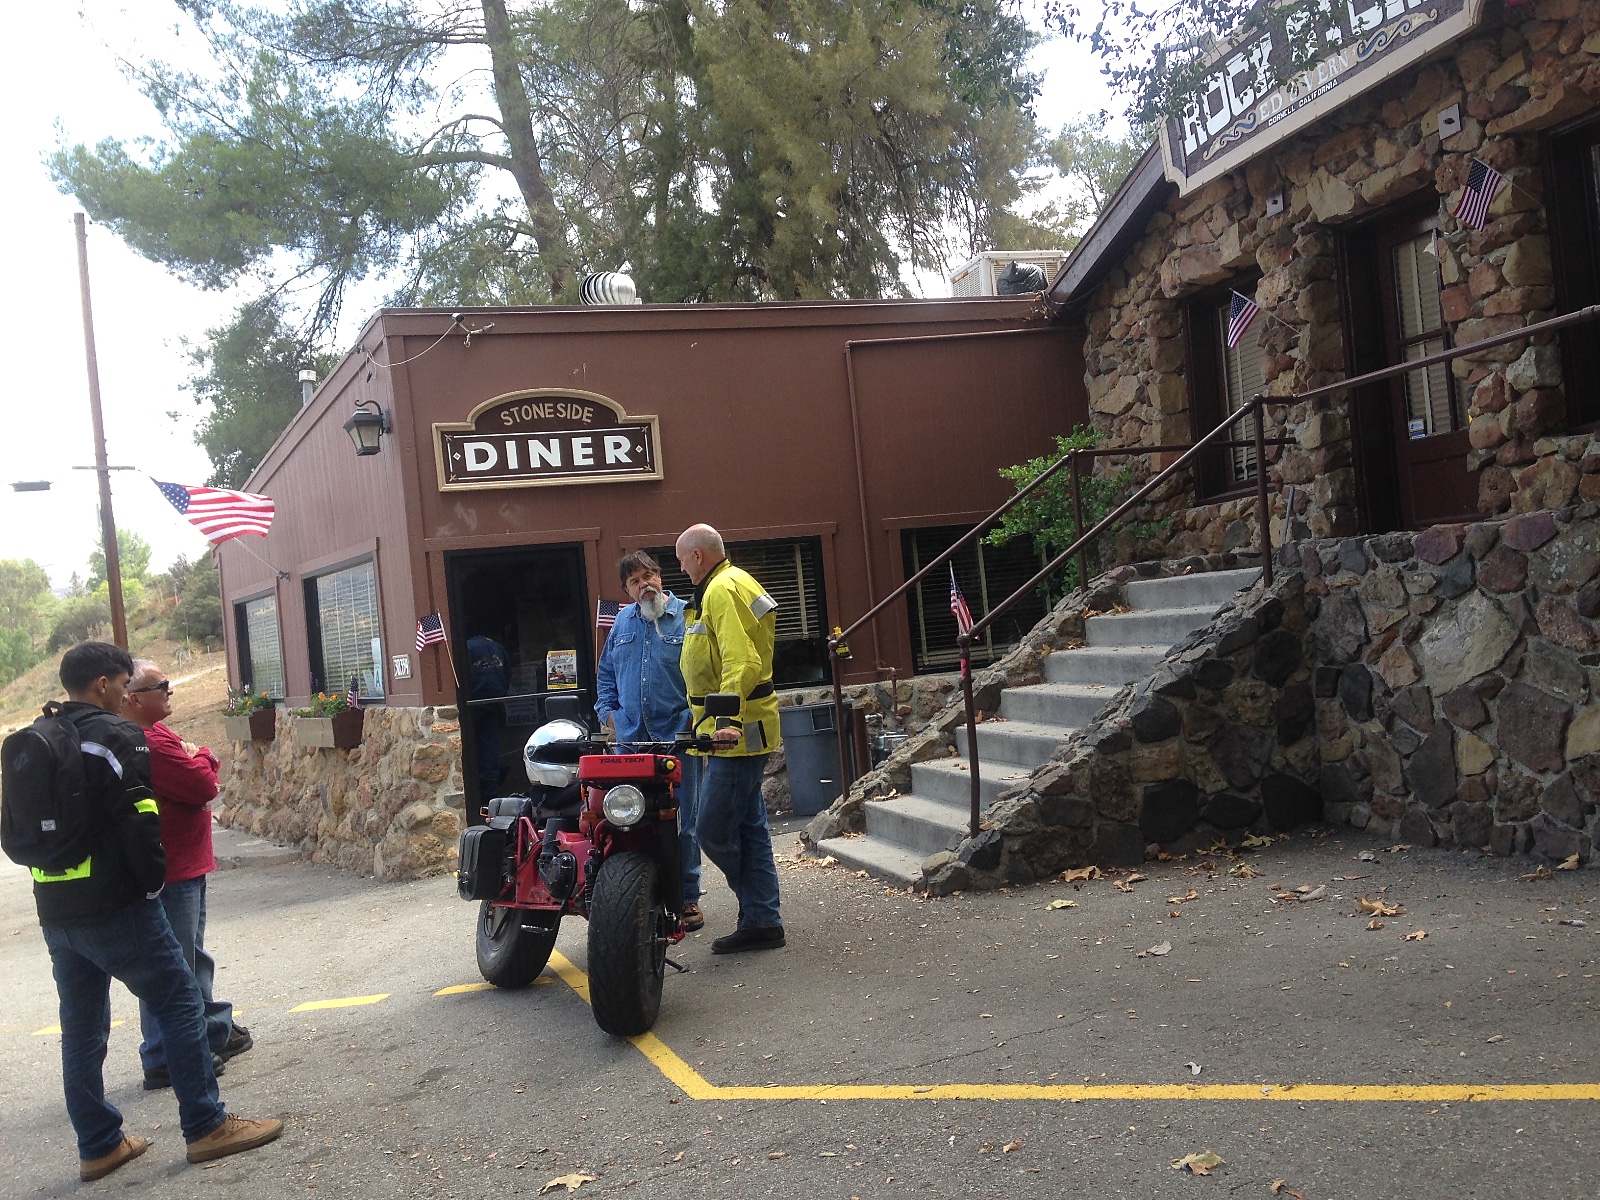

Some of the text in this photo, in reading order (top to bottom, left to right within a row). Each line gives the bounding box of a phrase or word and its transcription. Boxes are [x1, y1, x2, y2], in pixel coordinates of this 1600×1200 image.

[1183, 31, 1279, 157] ROCK
[1259, 92, 1283, 121] ED
[1268, 79, 1338, 127] CORNELL CALIFORNIA
[463, 435, 633, 472] DINER
